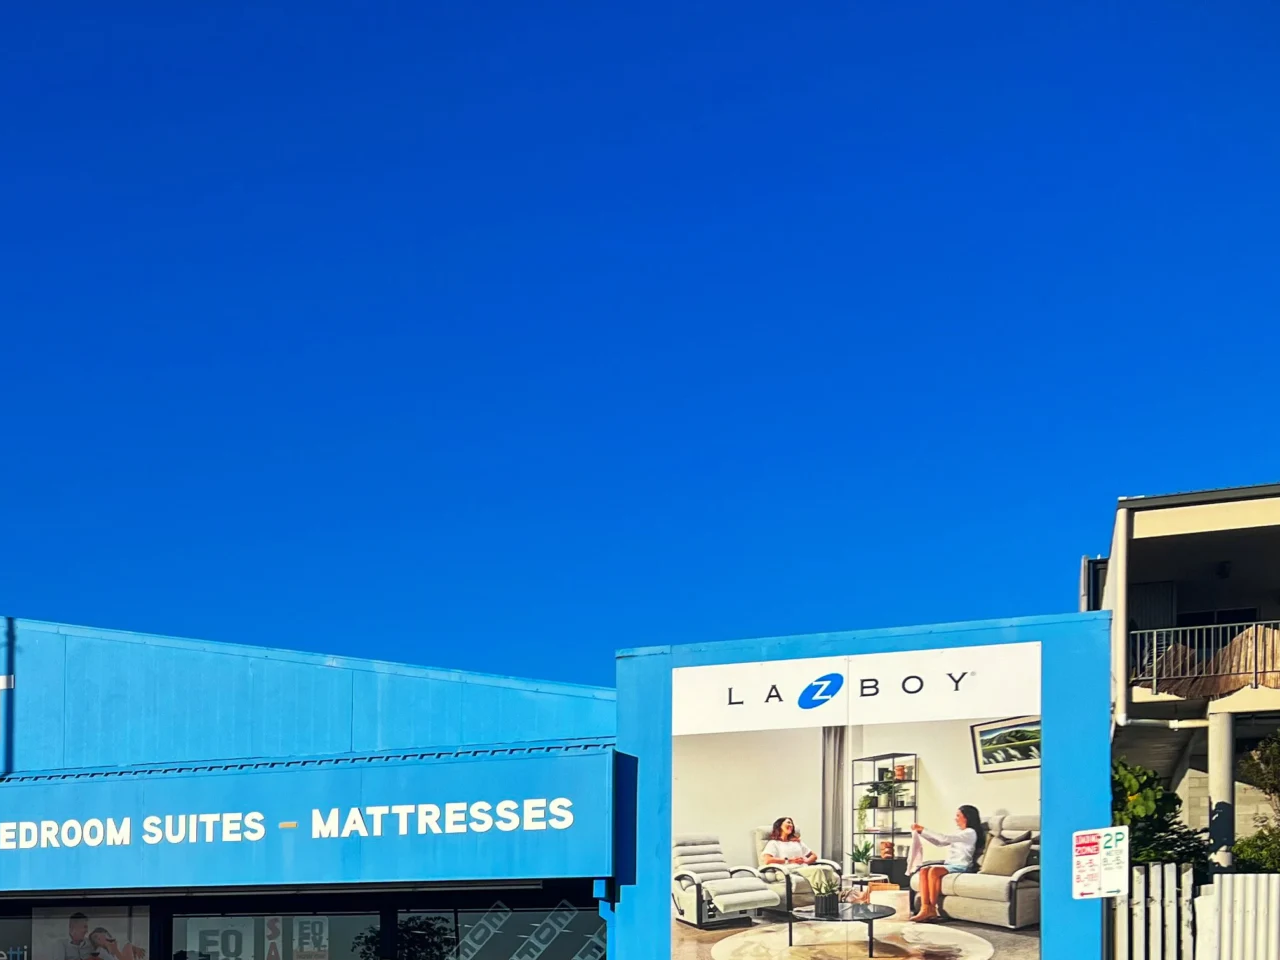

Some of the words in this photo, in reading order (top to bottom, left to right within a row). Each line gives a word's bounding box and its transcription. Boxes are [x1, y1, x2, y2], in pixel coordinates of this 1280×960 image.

[142, 811, 266, 845] SUITES
[311, 797, 575, 840] MATTRESSES
[1103, 832, 1126, 849] 2P
